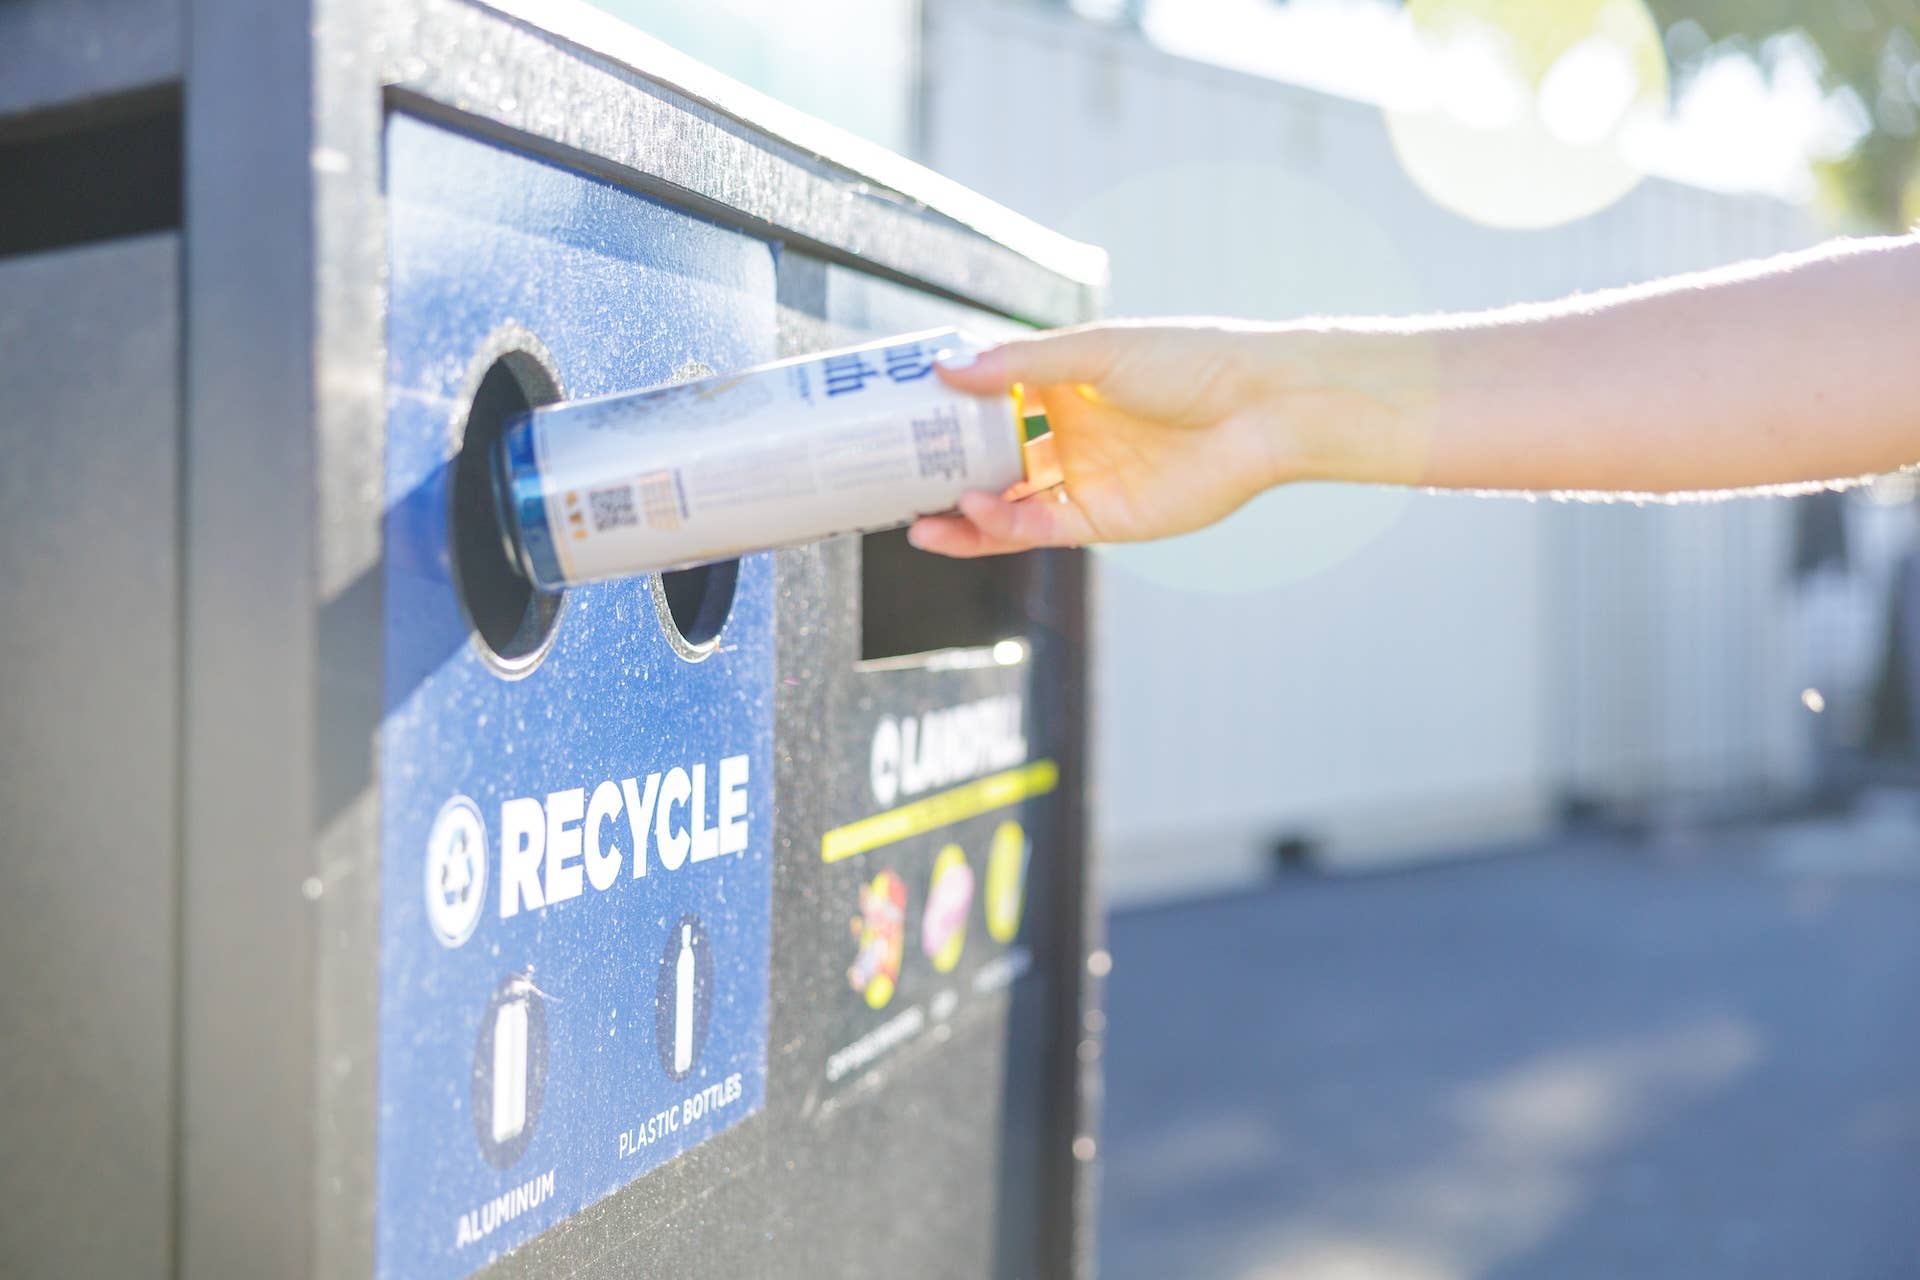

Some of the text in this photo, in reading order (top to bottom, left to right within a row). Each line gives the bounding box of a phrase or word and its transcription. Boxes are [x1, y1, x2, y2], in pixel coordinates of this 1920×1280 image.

[500, 754, 750, 919] RECYCLE
[618, 1073, 743, 1160] PLASTIC BOTTLES
[456, 1169, 555, 1249] ALUMINUM
